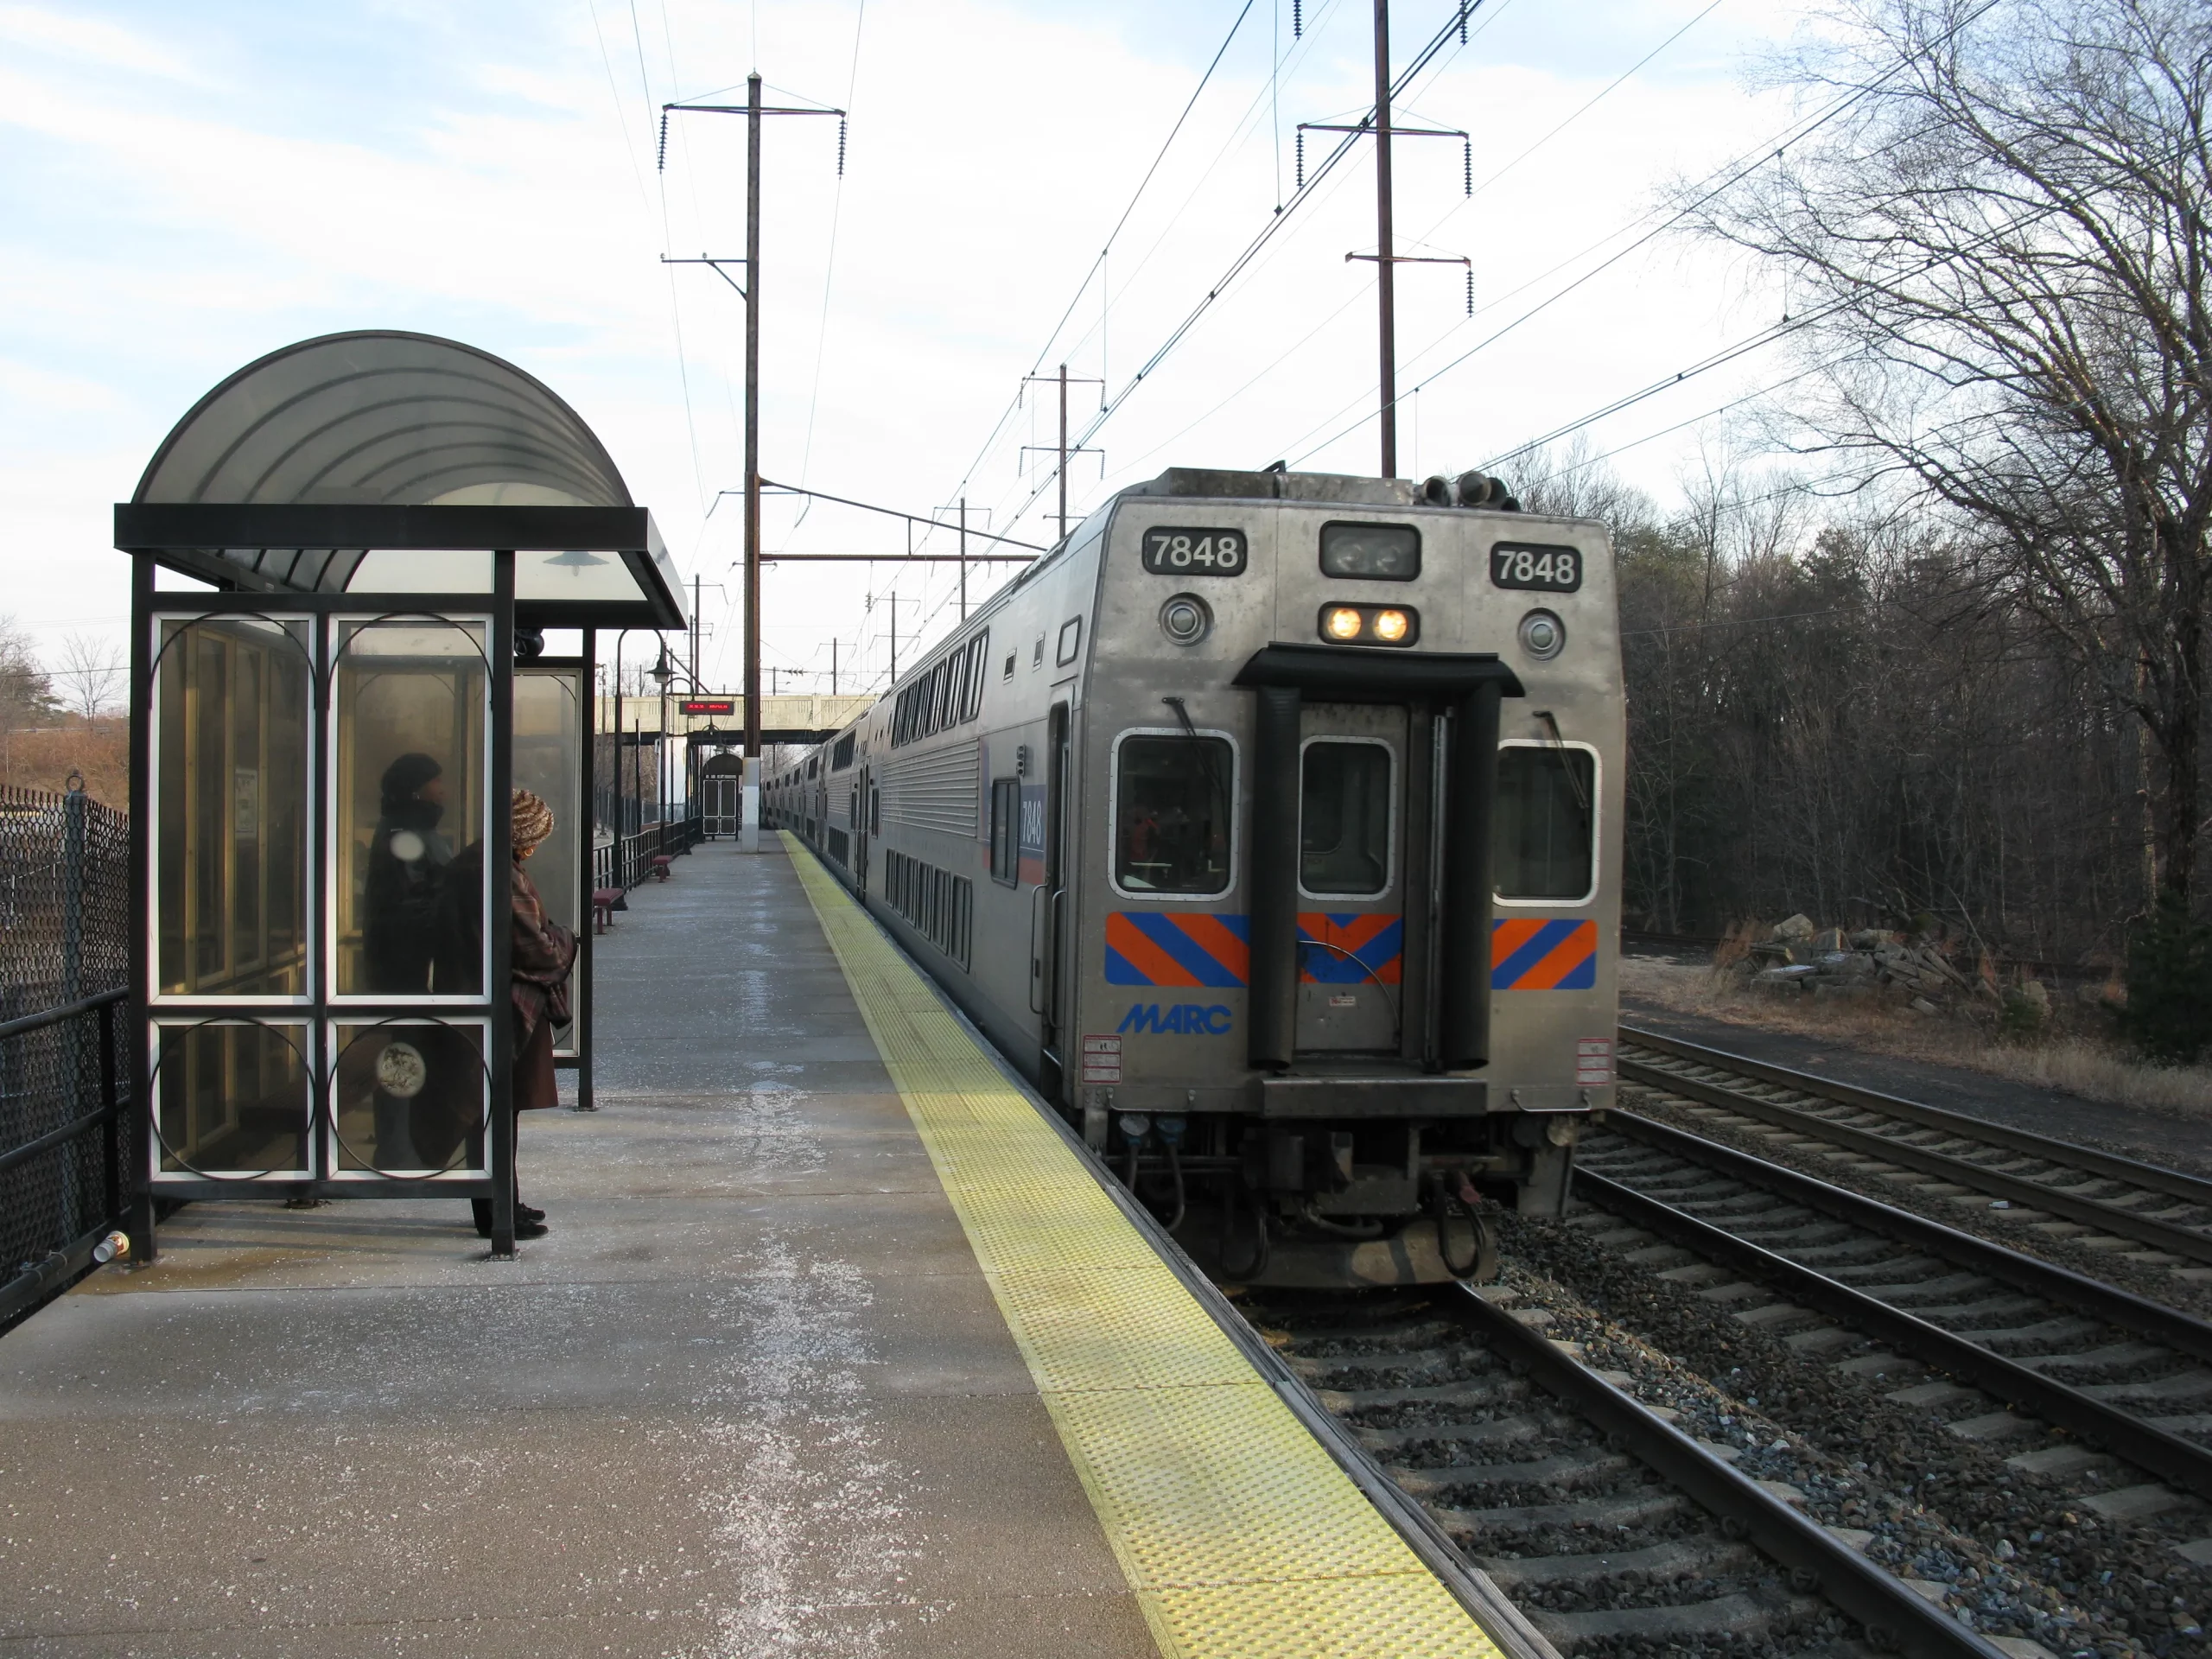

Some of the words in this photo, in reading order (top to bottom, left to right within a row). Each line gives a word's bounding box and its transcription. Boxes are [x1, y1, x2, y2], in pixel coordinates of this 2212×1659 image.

[1151, 535, 1238, 567] 7848
[1497, 550, 1574, 583] 7848
[1023, 800, 1041, 844] 7848
[1117, 1004, 1231, 1033] MARC
